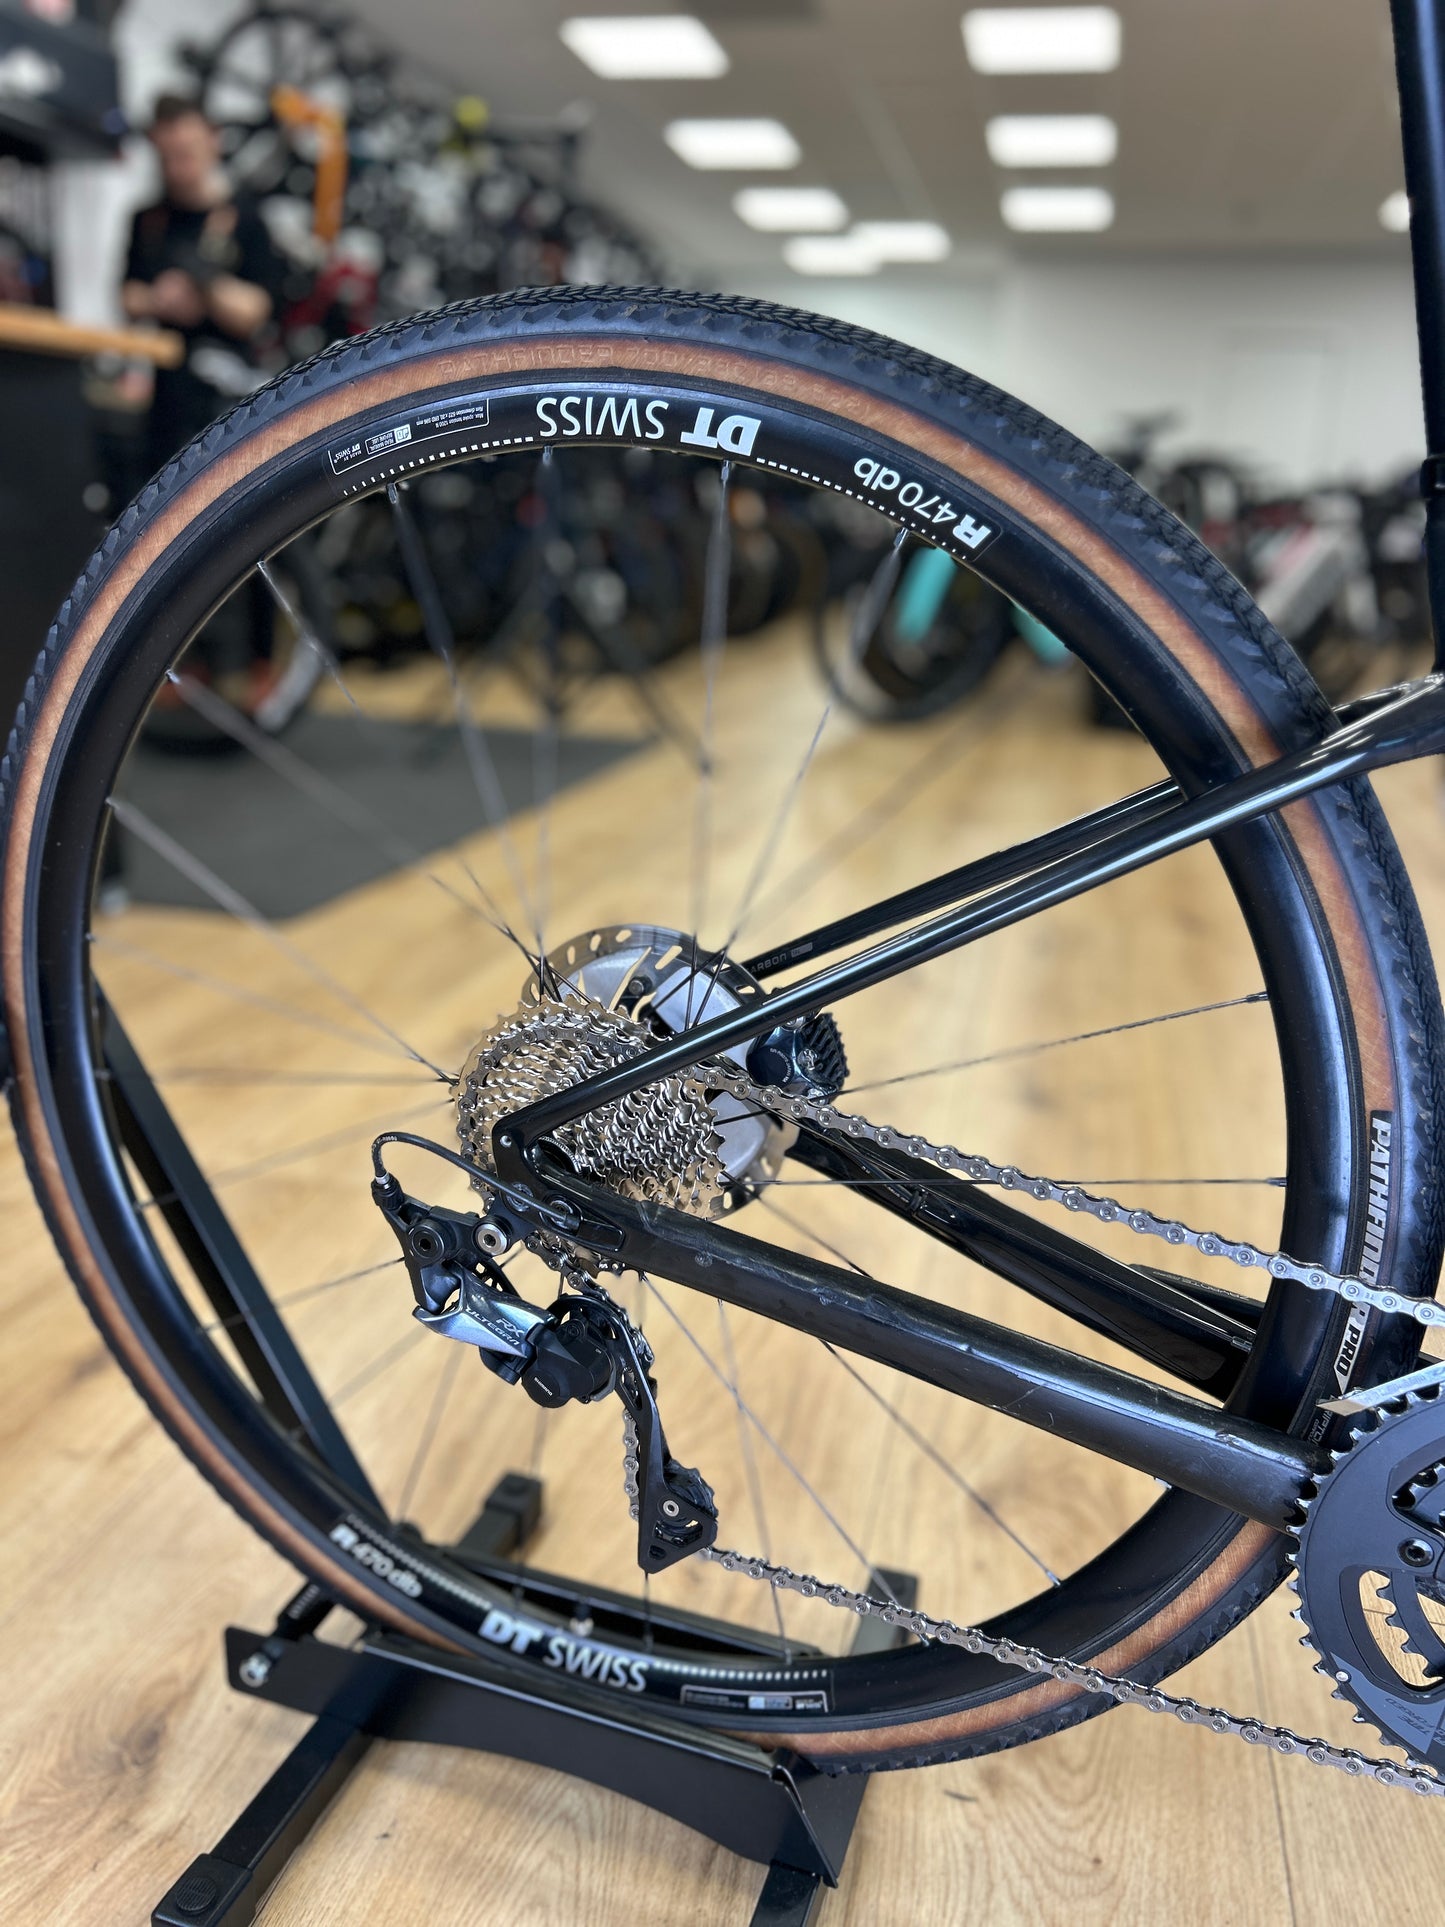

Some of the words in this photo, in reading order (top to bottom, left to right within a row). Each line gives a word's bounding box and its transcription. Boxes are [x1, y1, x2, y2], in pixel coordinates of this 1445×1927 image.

[536, 396, 669, 440] SWISS
[680, 408, 762, 457] DT
[351, 443, 361, 452] DT
[748, 952, 787, 974] ARBON
[1349, 1118, 1391, 1325] PATHFINDR
[465, 1304, 521, 1346] ULTEGRA
[495, 1317, 525, 1338] RX
[1337, 1324, 1360, 1378] PRO
[478, 1609, 544, 1654] DT
[542, 1636, 649, 1693] SWISS
